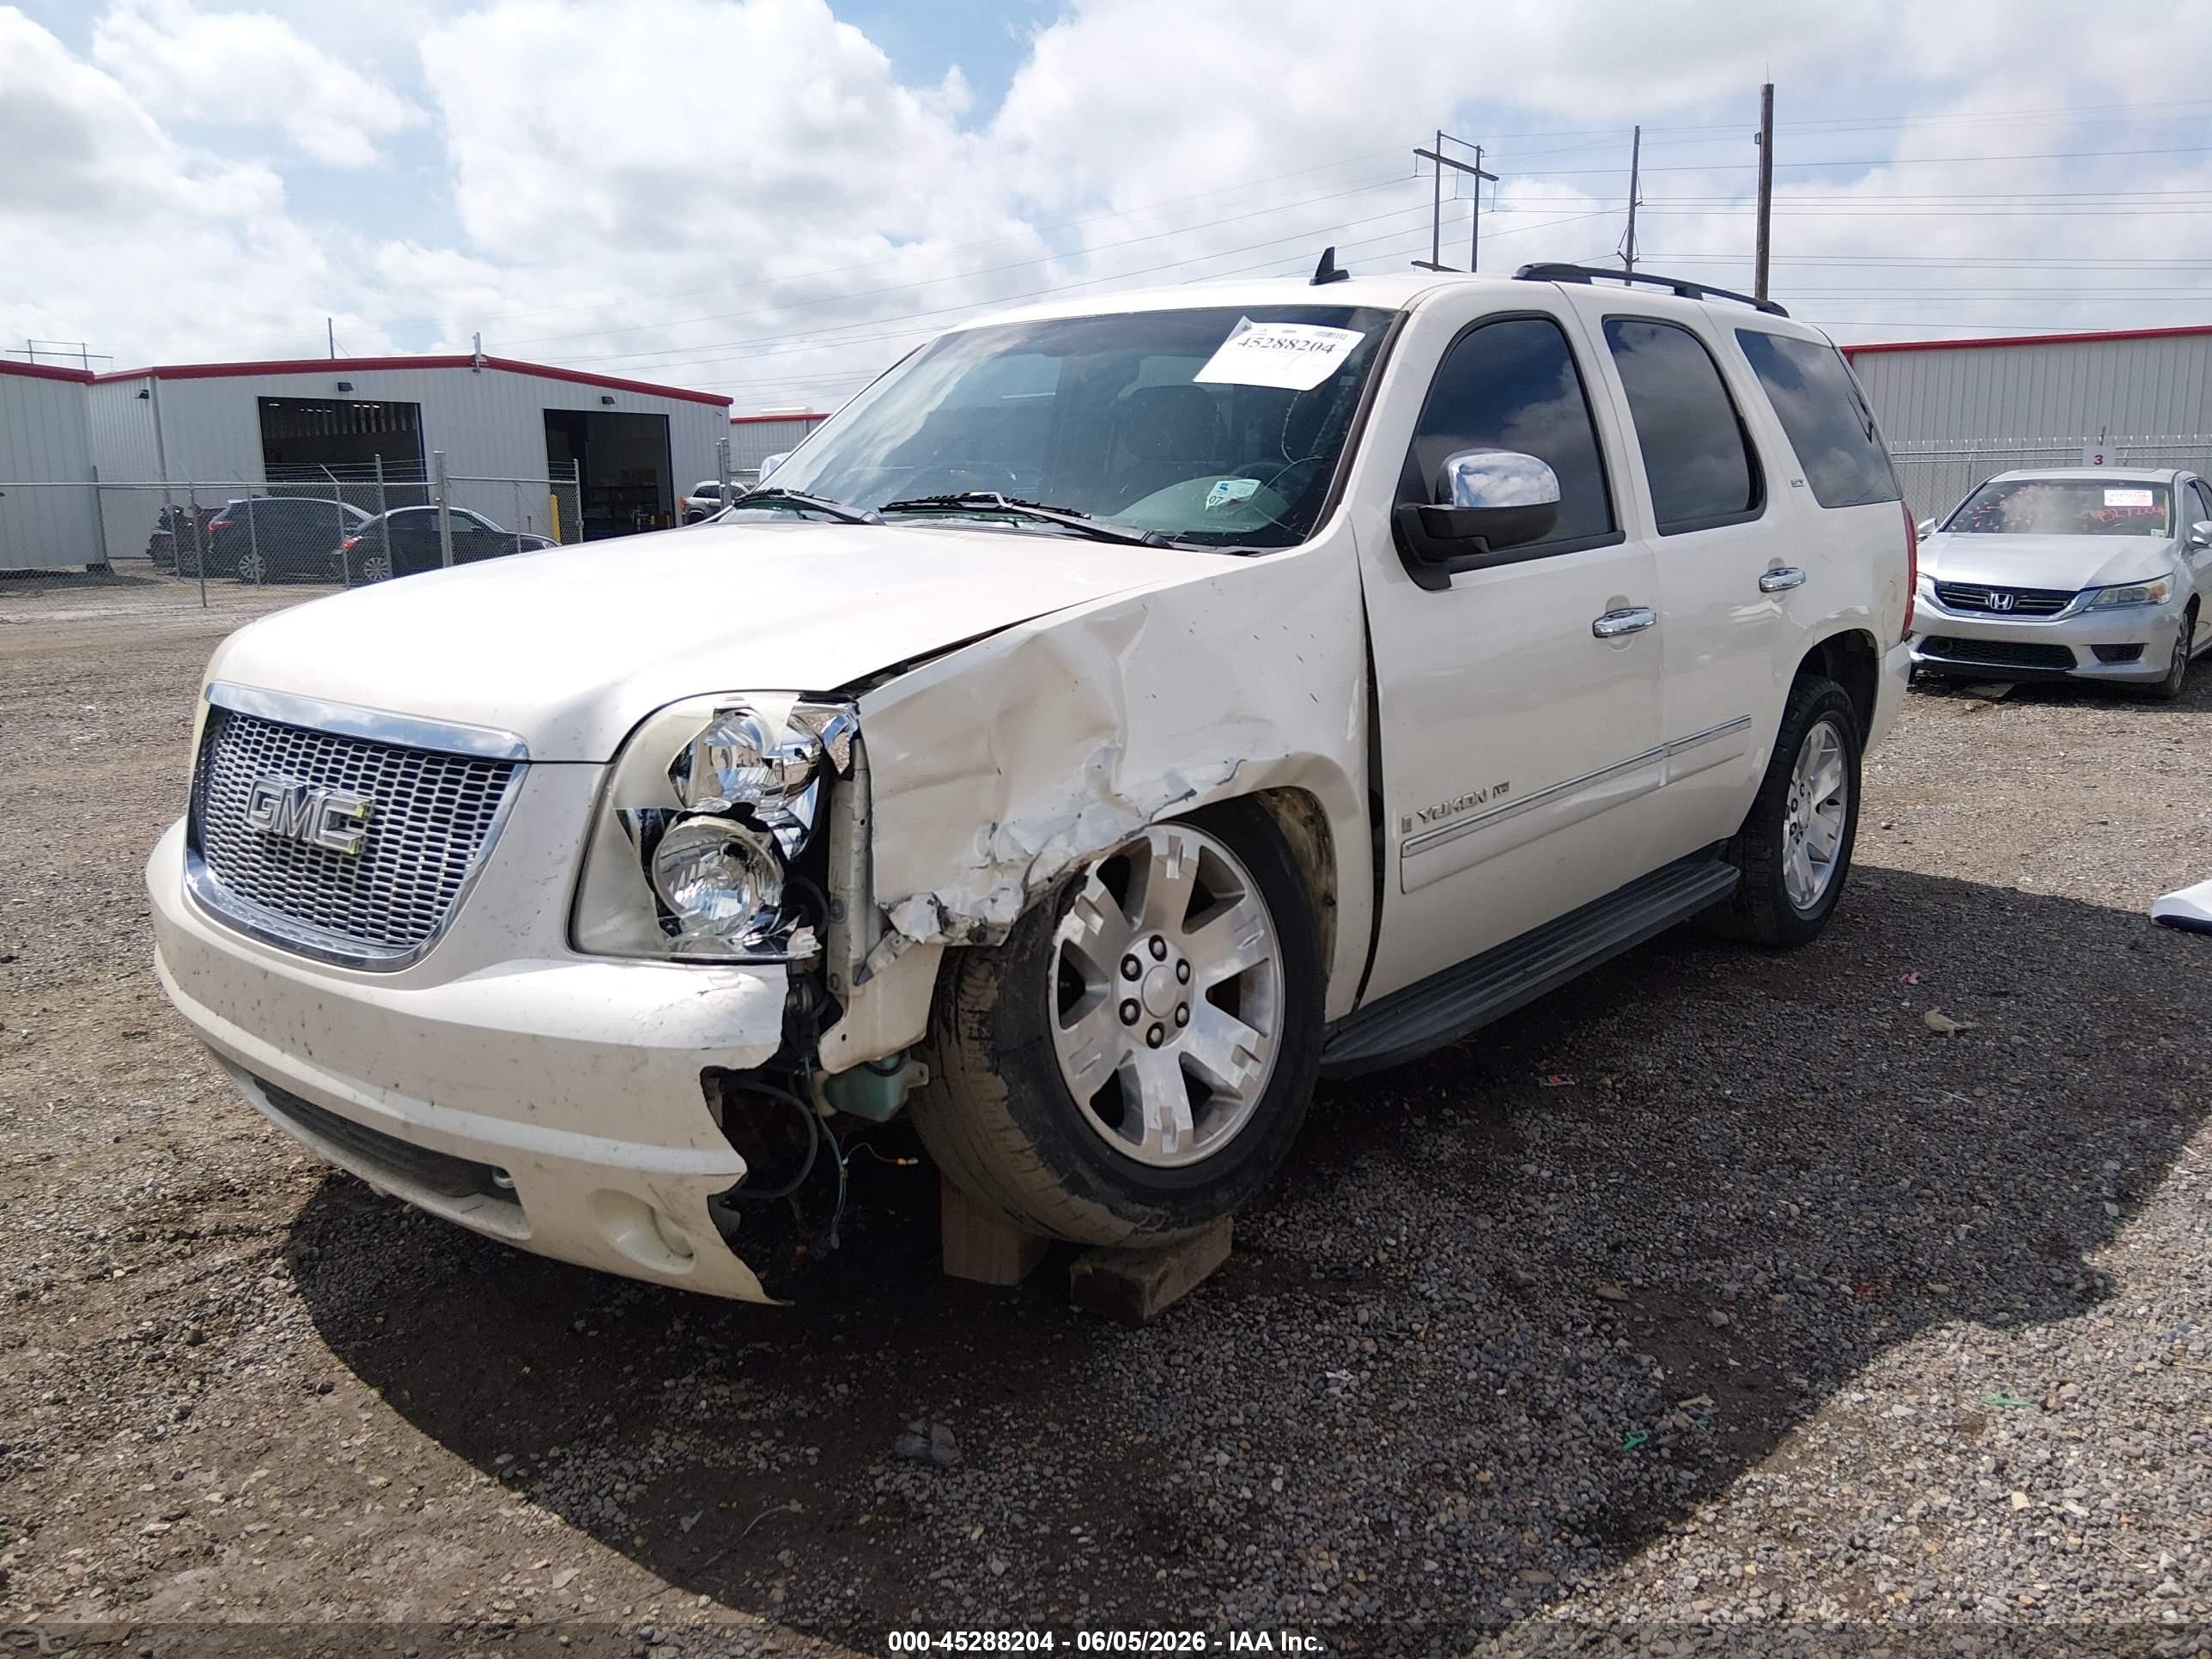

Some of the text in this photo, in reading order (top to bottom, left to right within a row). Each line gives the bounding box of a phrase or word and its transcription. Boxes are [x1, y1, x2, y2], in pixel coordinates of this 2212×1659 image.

[1237, 337, 1337, 354] 45288204
[2094, 454, 2104, 465] 3
[1208, 495, 1224, 505] 07
[245, 775, 375, 855] GMC
